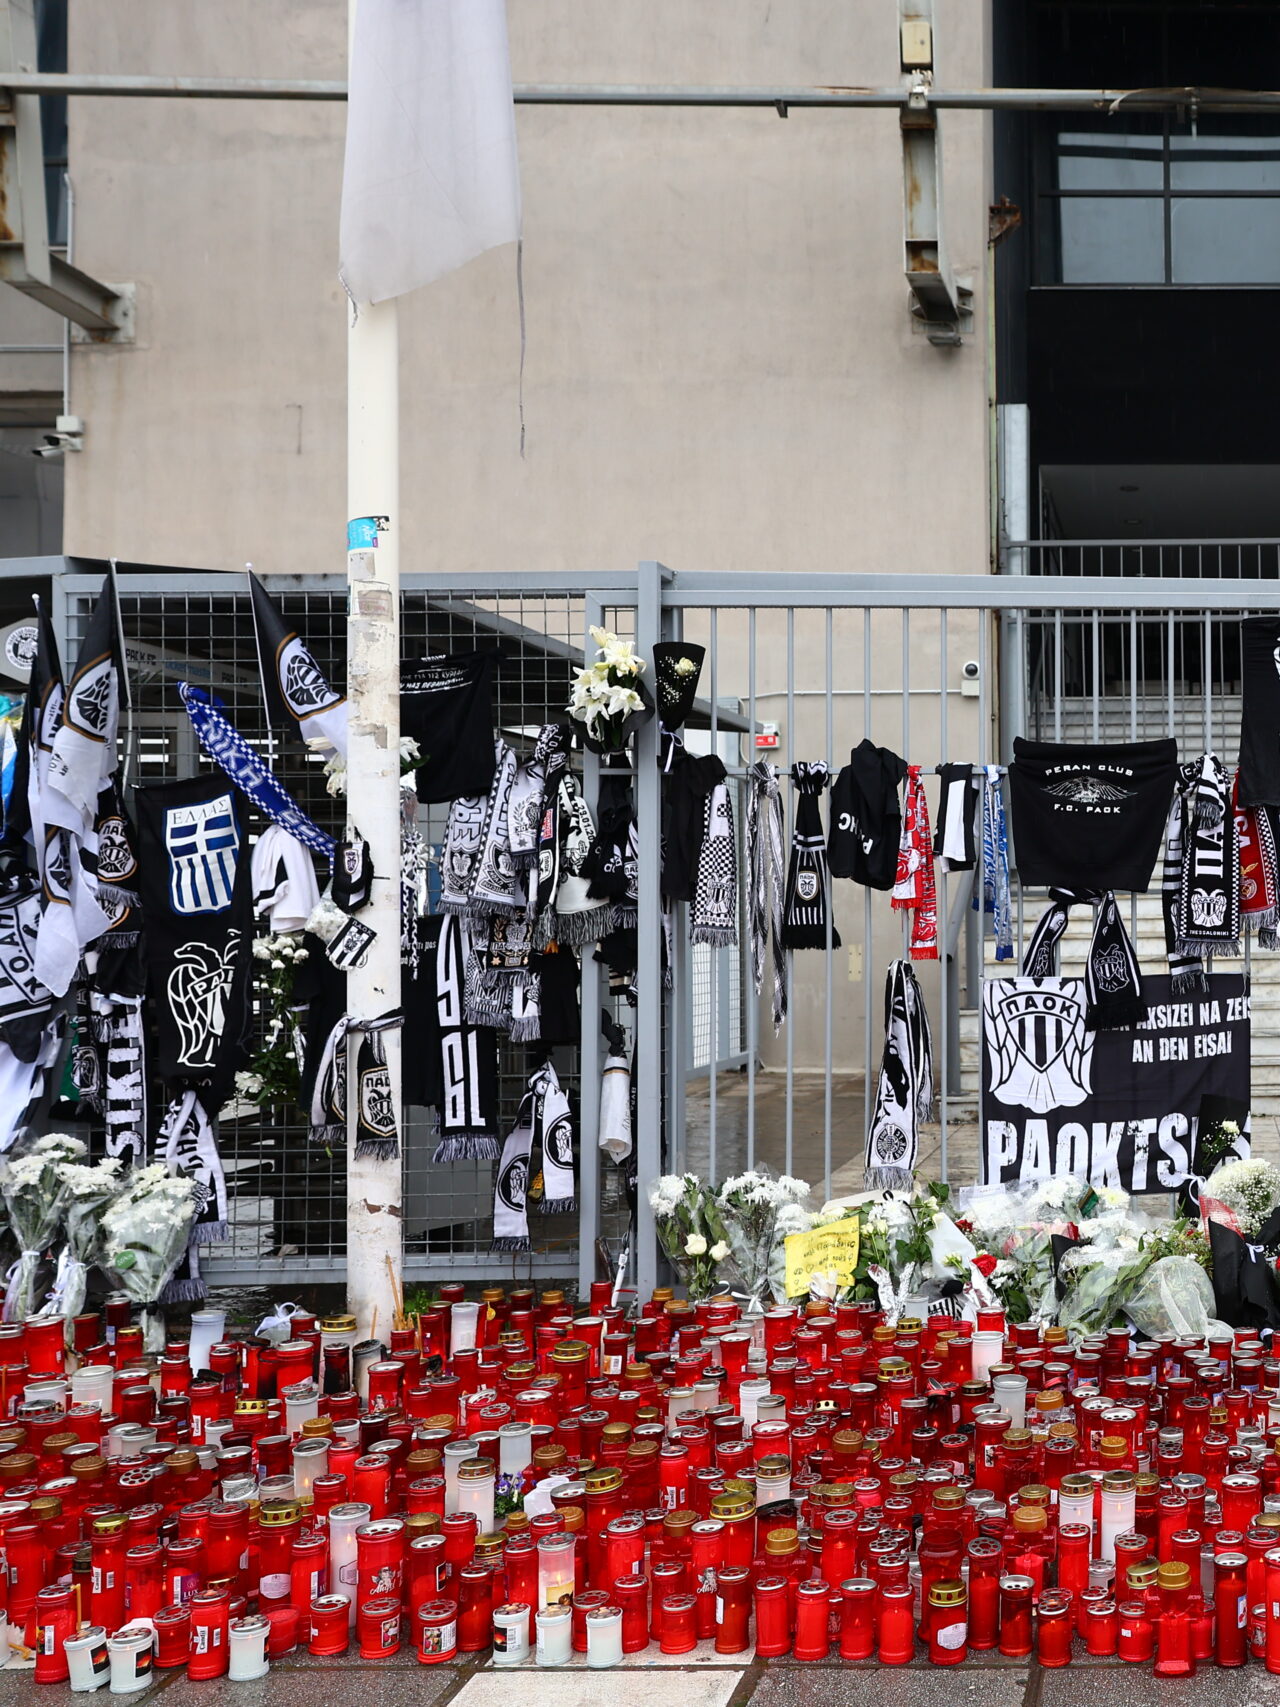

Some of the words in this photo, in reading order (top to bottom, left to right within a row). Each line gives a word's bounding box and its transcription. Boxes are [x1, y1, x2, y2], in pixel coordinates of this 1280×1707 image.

[1044, 764, 1091, 777] PERAN
[1098, 764, 1134, 777] CLUB
[172, 798, 229, 826] ΕΛΛΑΣ
[1053, 803, 1079, 812] F.C.
[1086, 805, 1121, 814] PAOK
[1006, 994, 1075, 1020] ΠΑΟΚ
[1199, 1001, 1221, 1026] NA
[1132, 1038, 1154, 1063] AN
[1158, 1037, 1189, 1061] DEN
[1193, 1030, 1233, 1059] EISAI
[183, 1589, 200, 1600] LUX
[199, 1630, 208, 1654] Candil
